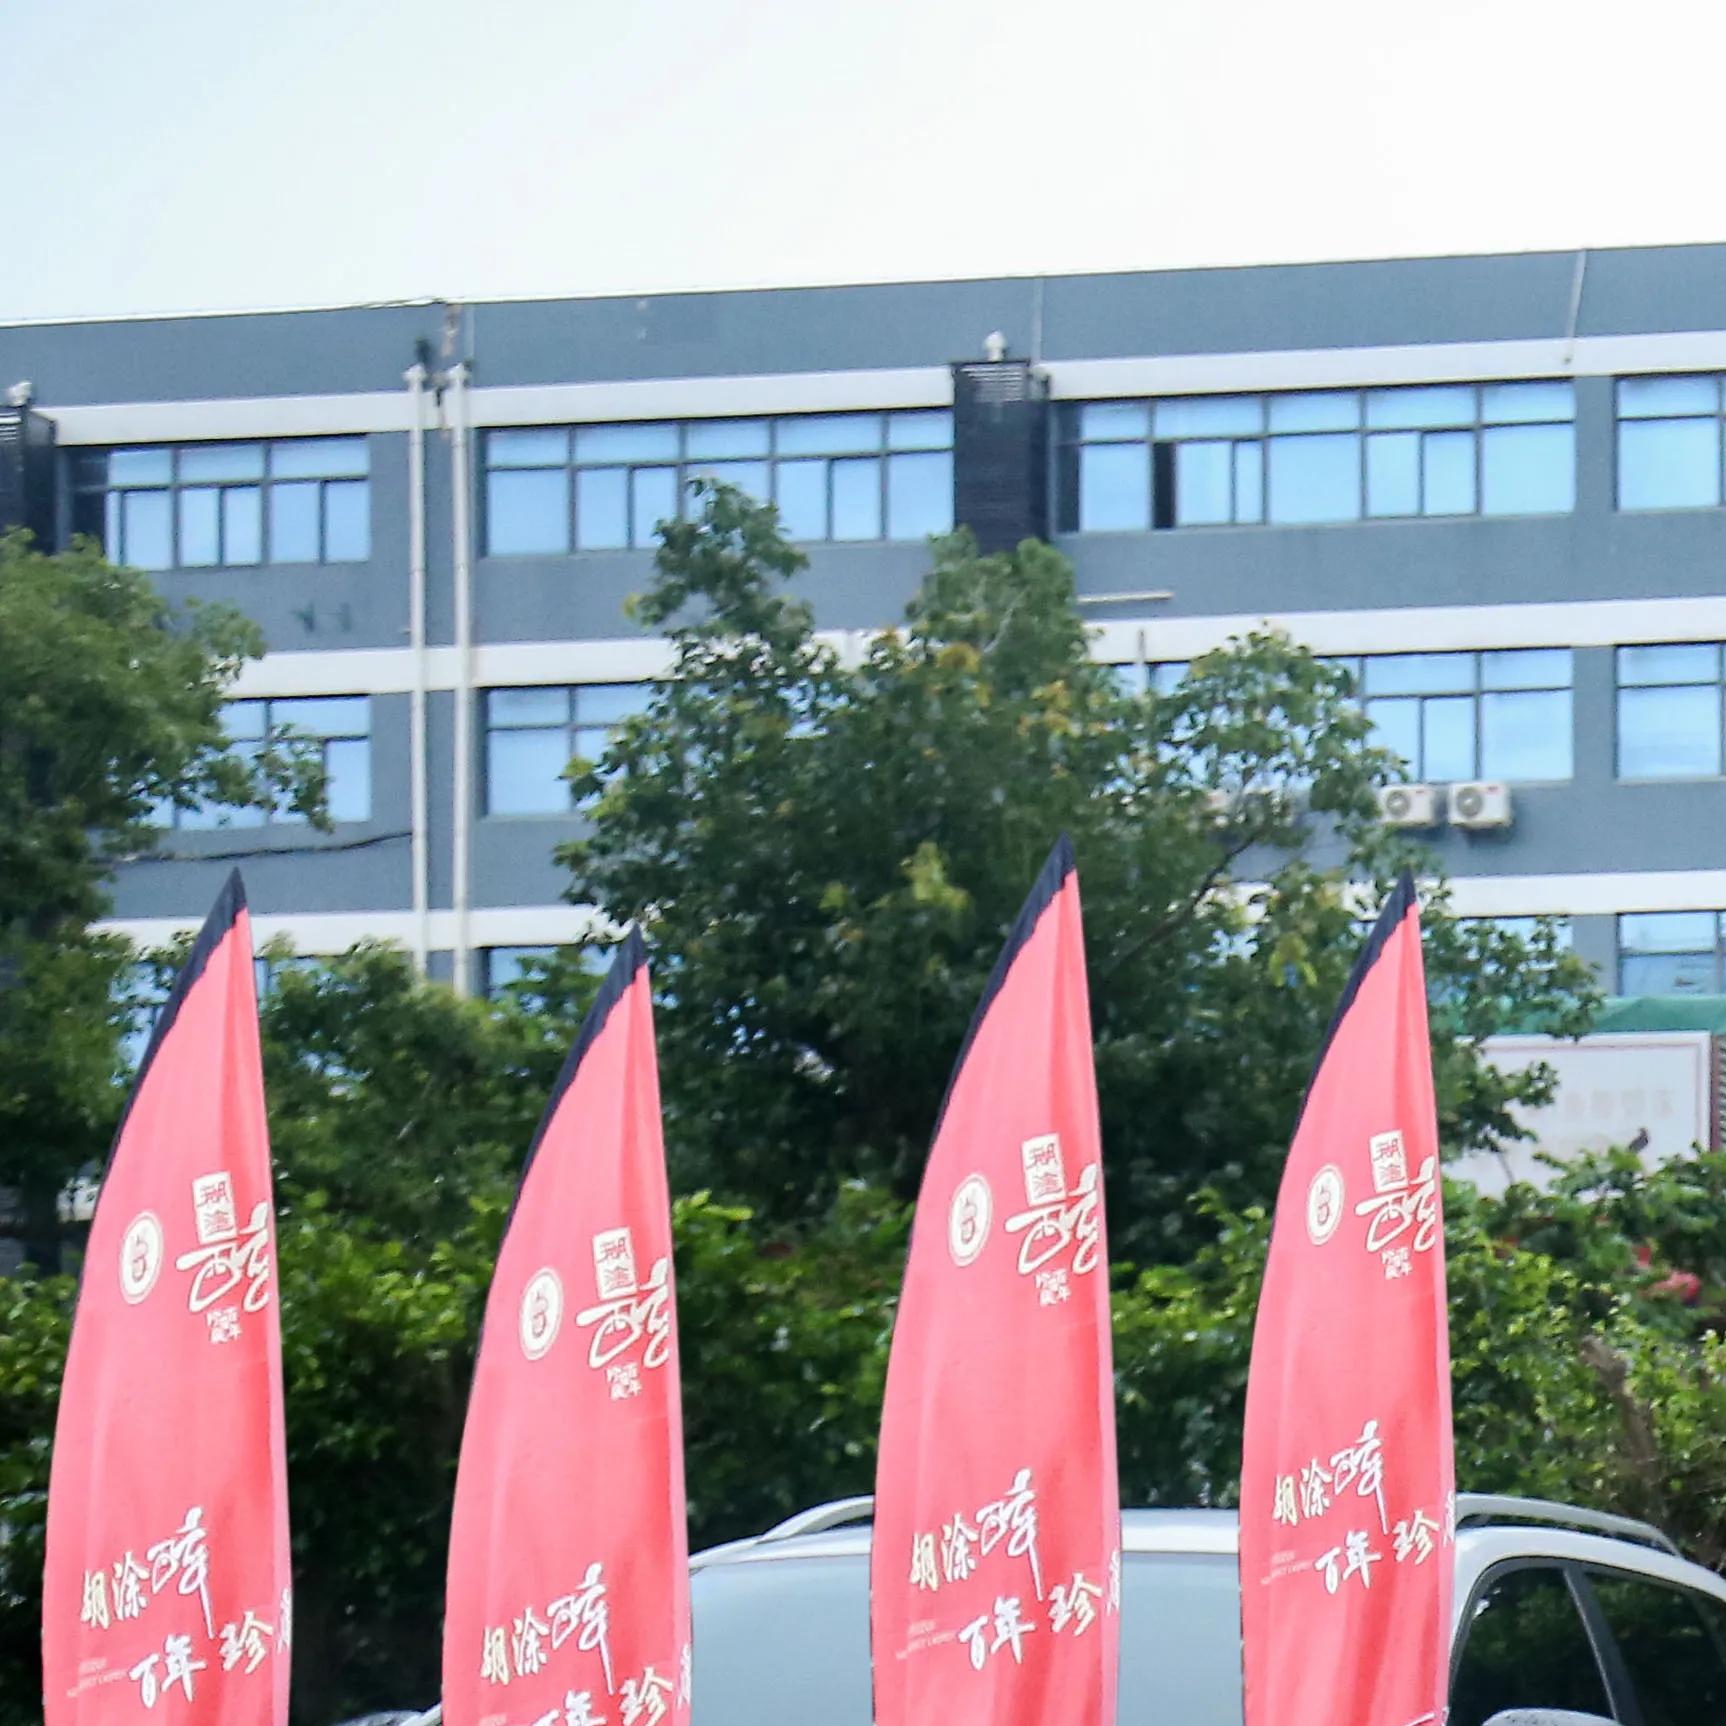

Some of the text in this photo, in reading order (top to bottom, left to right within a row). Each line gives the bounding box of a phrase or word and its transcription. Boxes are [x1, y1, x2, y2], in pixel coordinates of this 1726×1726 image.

[1315, 1490, 1454, 1594] 百年珍
[129, 1588, 292, 1708] 百年珍
[959, 1549, 1120, 1670] 百年珍
